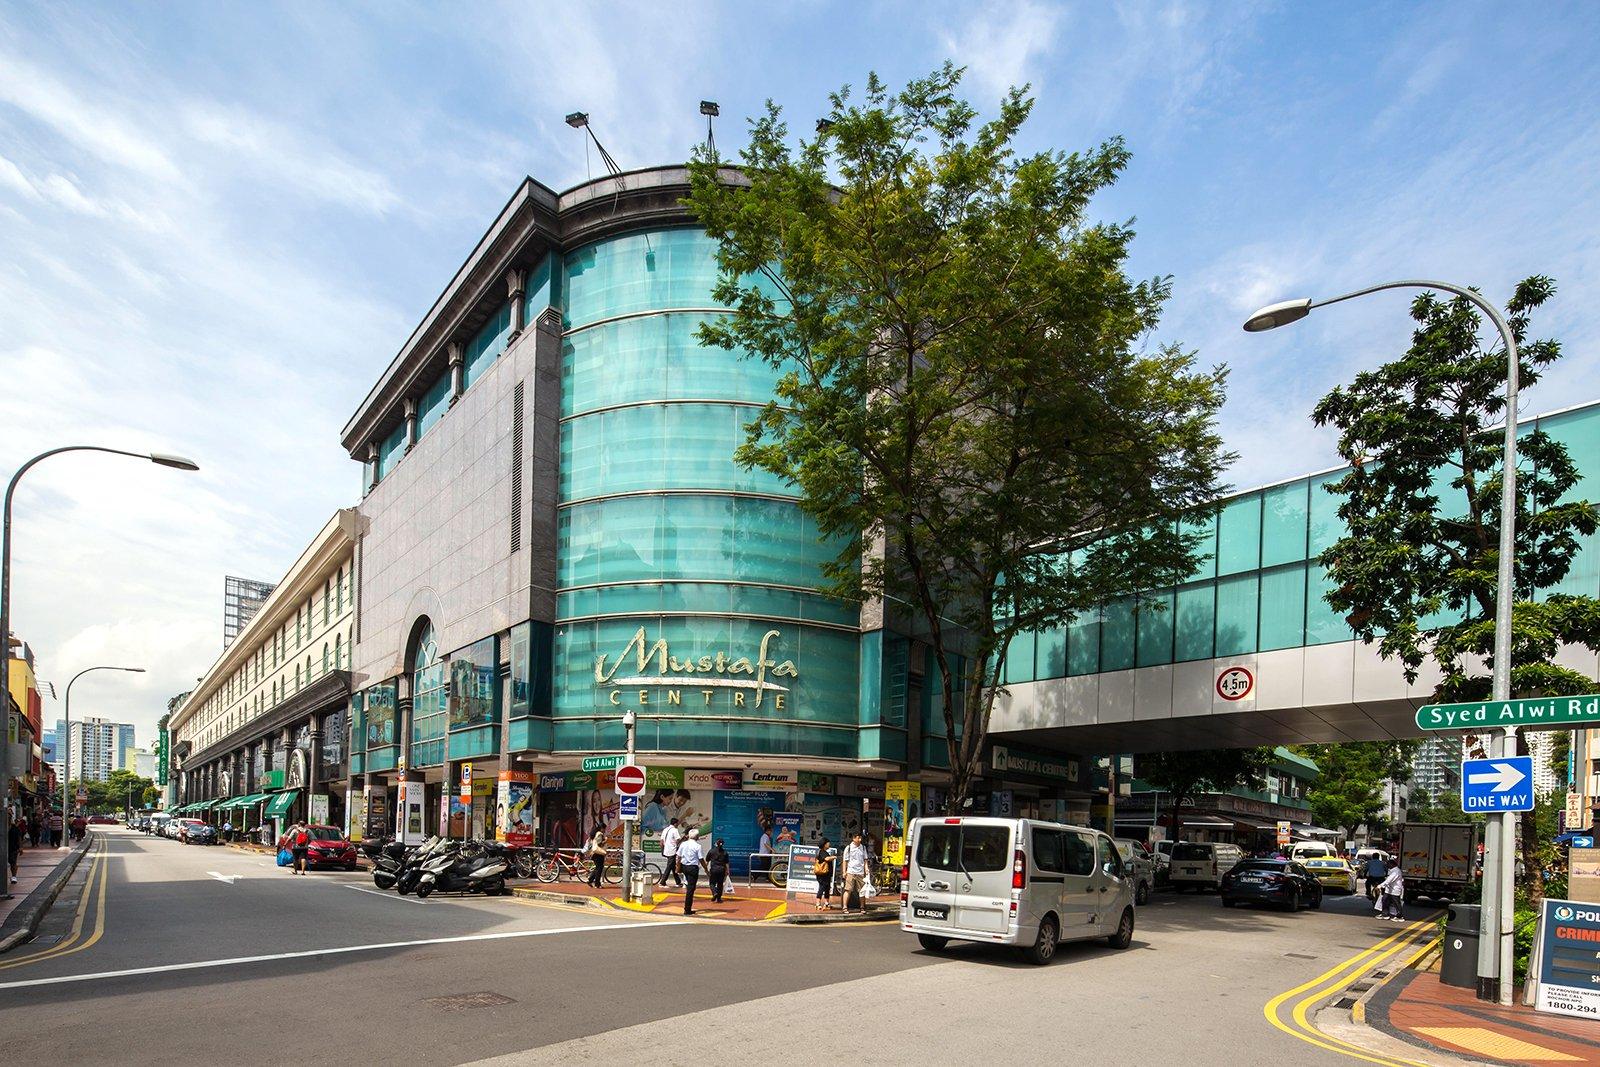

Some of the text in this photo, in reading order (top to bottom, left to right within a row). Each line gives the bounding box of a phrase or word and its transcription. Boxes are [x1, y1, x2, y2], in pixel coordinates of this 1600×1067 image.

[595, 625, 798, 709] Mustafa
[1222, 678, 1248, 691] 4.5m
[609, 689, 786, 710] CENTRE
[1430, 698, 1599, 726] Syed Alwi Rd
[585, 756, 624, 769] Syed Alwi Rd
[1007, 756, 1068, 777] MUSTAFA CENTRE
[752, 772, 789, 782] Centrum
[929, 800, 934, 811] 3
[1002, 802, 1009, 813] 3
[1468, 794, 1527, 808] ONE WAY
[1547, 1001, 1598, 1014] 1800-294
